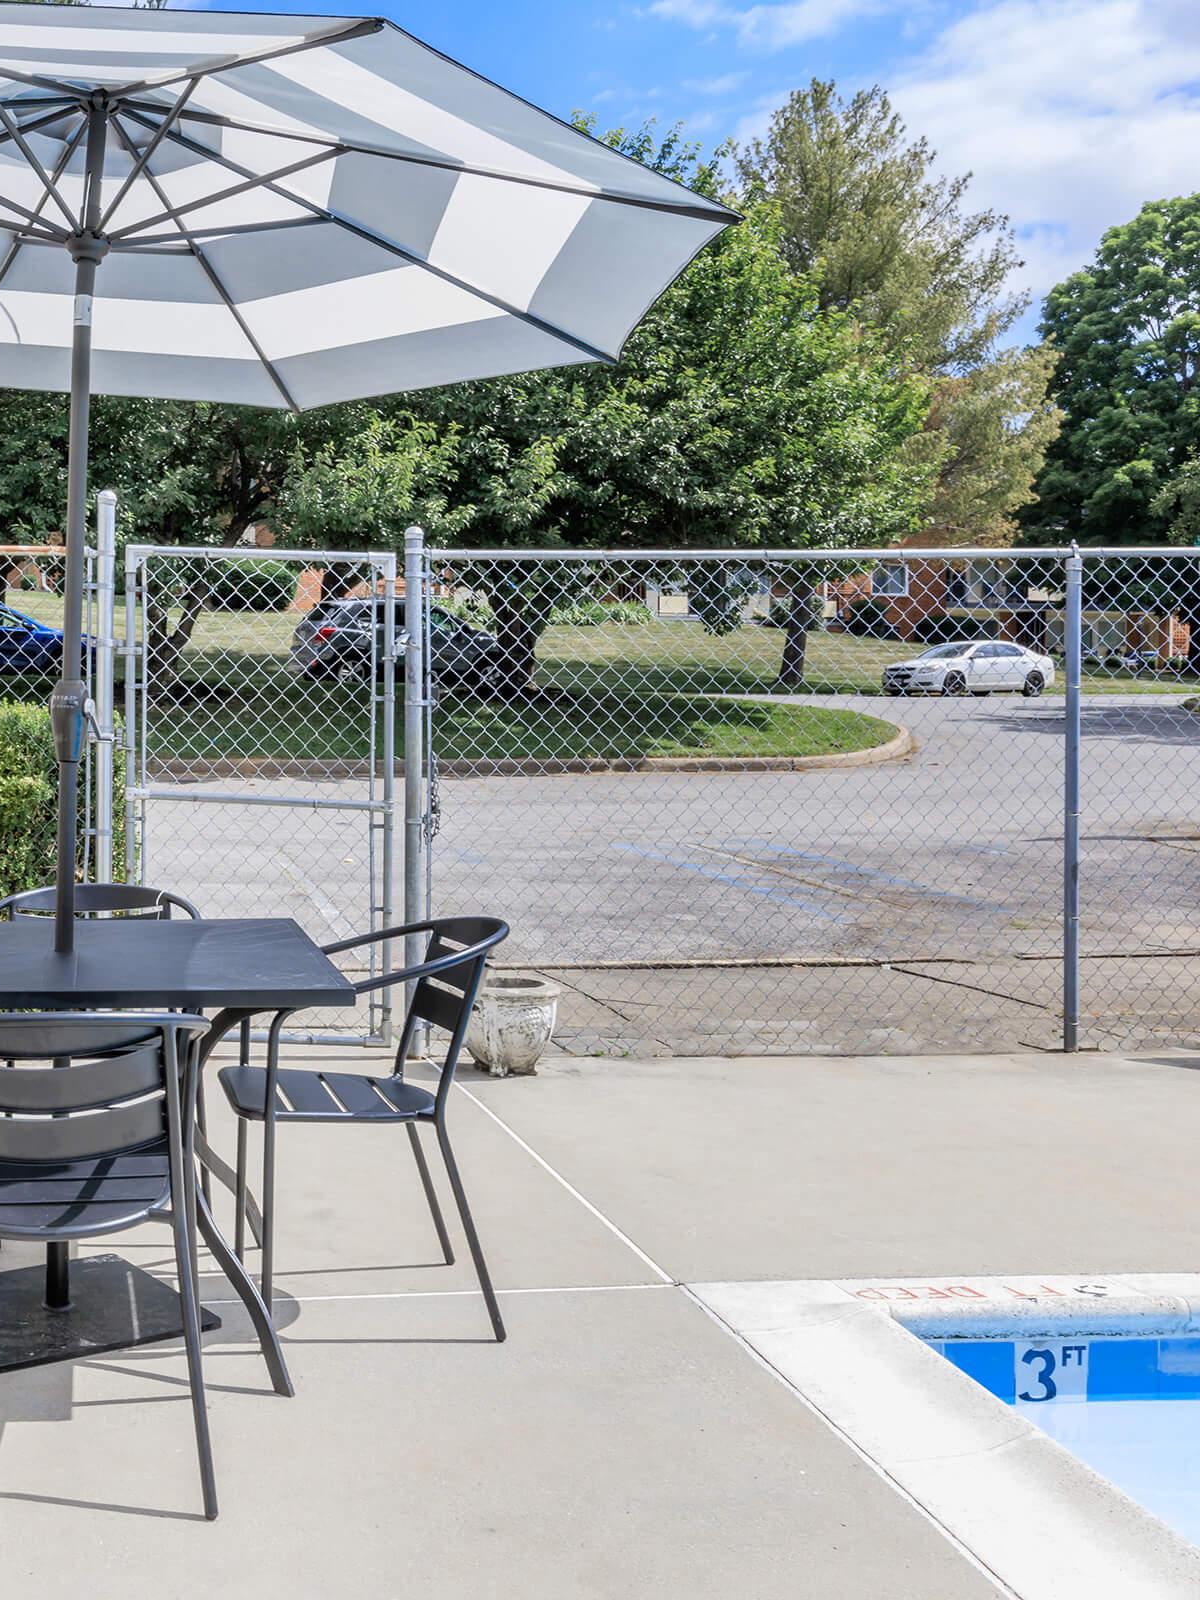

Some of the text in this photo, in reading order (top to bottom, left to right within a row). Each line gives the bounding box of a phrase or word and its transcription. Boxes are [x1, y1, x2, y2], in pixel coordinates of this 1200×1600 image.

[855, 1285, 987, 1300] DEEP
[1018, 1345, 1087, 1402] 3 FT
